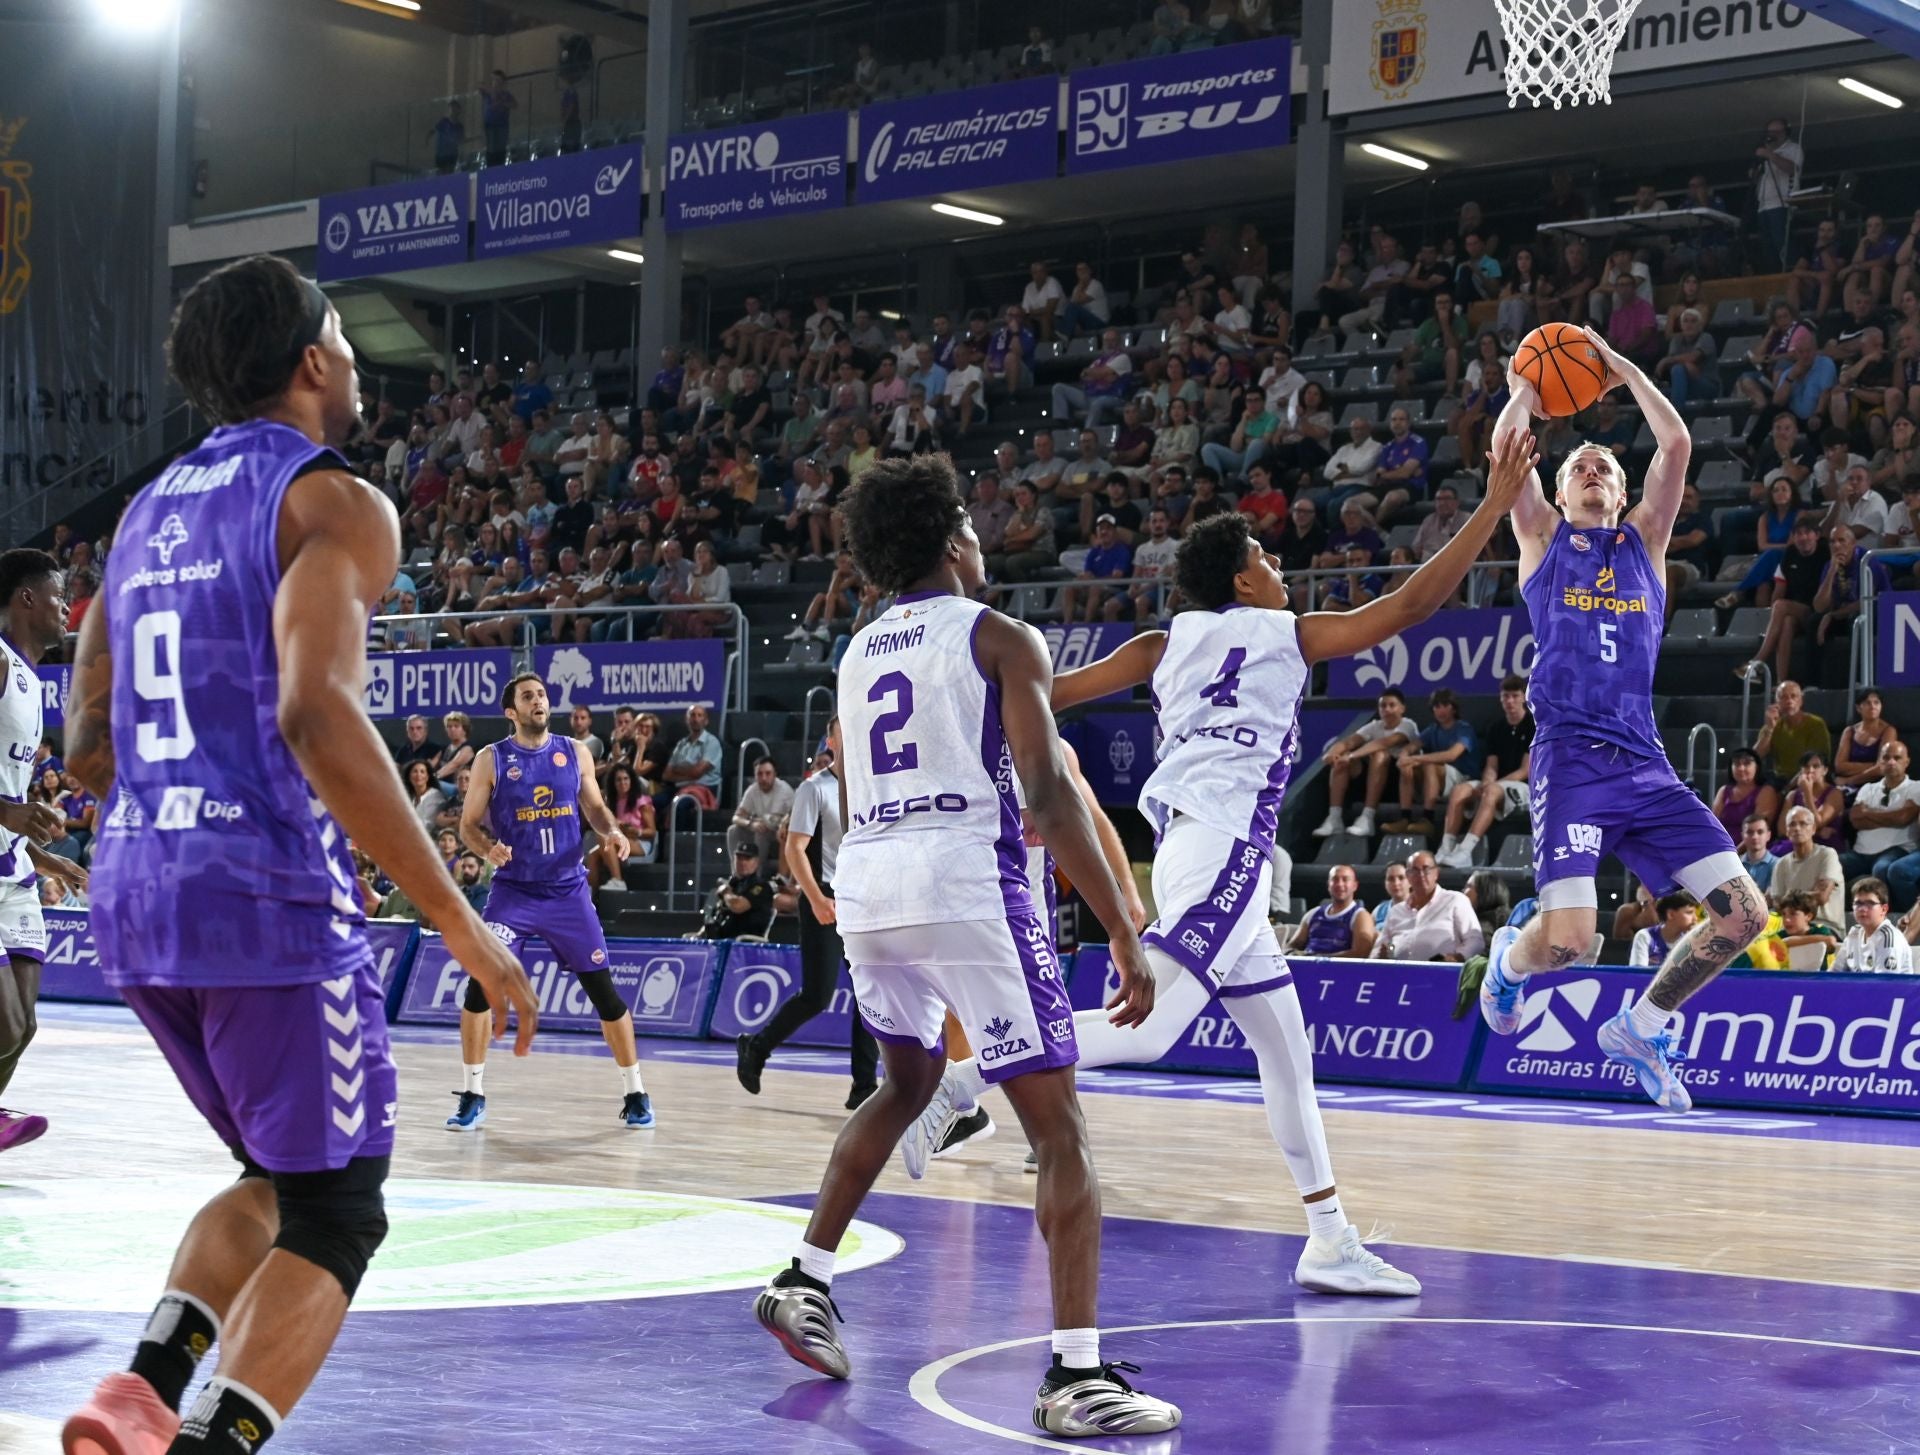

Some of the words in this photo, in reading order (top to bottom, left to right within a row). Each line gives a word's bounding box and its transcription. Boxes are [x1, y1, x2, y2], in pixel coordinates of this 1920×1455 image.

[1465, 0, 1807, 80] Amiento
[1142, 68, 1277, 100] Transportes
[902, 106, 1051, 147] NEUMÁTICOS
[1135, 95, 1283, 139] BUJ
[769, 159, 841, 184] Trans
[893, 138, 1008, 173] PALENCIA
[485, 175, 548, 197] Interiorismo
[680, 198, 744, 220] Transporte
[748, 192, 765, 211] de
[769, 183, 828, 207] Vehículos
[357, 194, 459, 235] VAYMA
[485, 193, 591, 232] Villanova
[352, 244, 386, 259] LIMPIEZA
[389, 243, 395, 254] Y
[397, 232, 460, 252] MANTENIMIENTO
[179, 557, 223, 582] salud
[1563, 595, 1648, 616] agropal
[865, 623, 926, 658] HANNA
[1600, 622, 1618, 664] 5
[133, 610, 197, 763] 9
[401, 661, 498, 708] PETKUS
[601, 661, 705, 696] TECNICAMPO
[1199, 647, 1247, 709] 4
[867, 670, 919, 776] 2
[204, 800, 243, 823] Dip
[516, 804, 574, 822] agropal
[540, 827, 555, 855] 11
[45, 919, 88, 932] GRUPO
[1181, 928, 1210, 955] CBC
[1048, 1017, 1071, 1038] CBC
[1187, 1016, 1254, 1050] RE
[981, 1037, 1032, 1063] CRZA
[1506, 1054, 1594, 1079] cámaras
[1600, 1058, 1721, 1086] frigficas
[1743, 1071, 1919, 1100] www.proylam.
[1074, 1071, 1818, 1131] alencia
